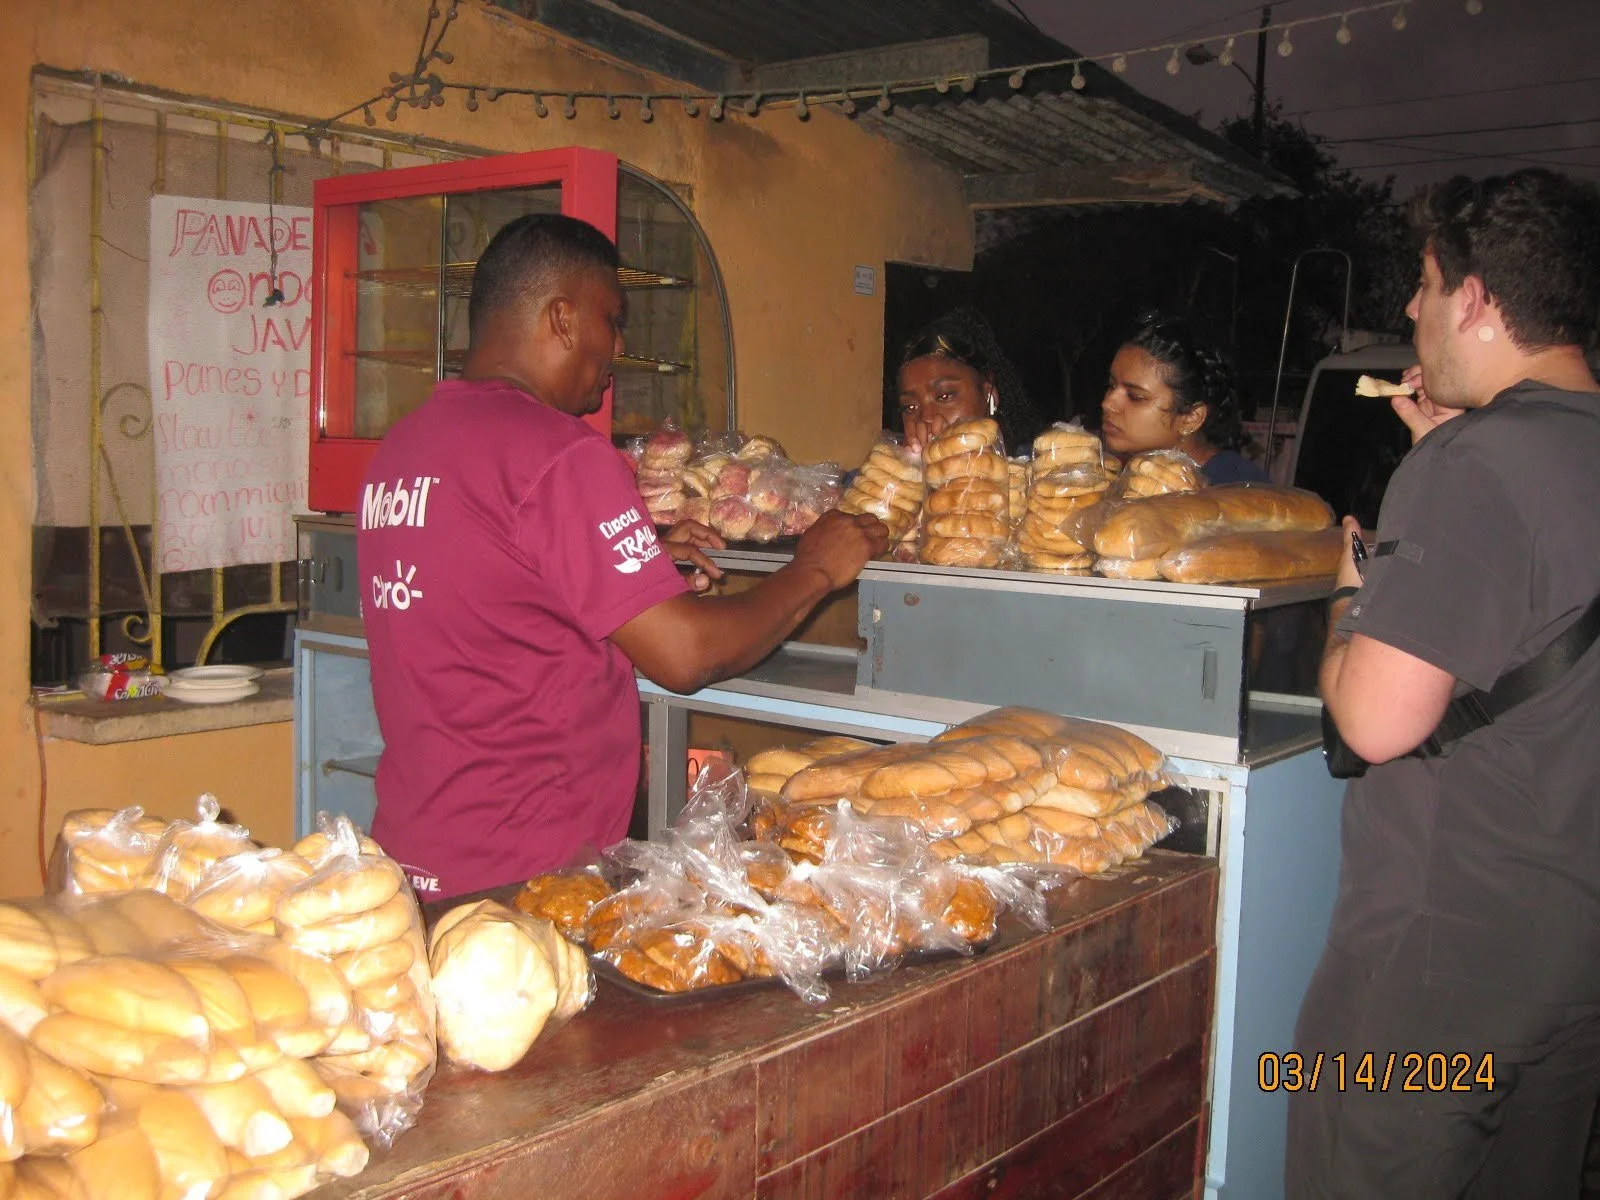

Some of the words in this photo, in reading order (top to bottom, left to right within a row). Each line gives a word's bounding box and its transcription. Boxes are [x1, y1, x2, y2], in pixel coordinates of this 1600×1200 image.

[169, 208, 312, 258] PANADE
[231, 314, 312, 355] JAV
[294, 368, 311, 397] D
[362, 476, 432, 530] Mobil
[612, 525, 656, 560] TRAIL
[408, 874, 441, 892] EVE.
